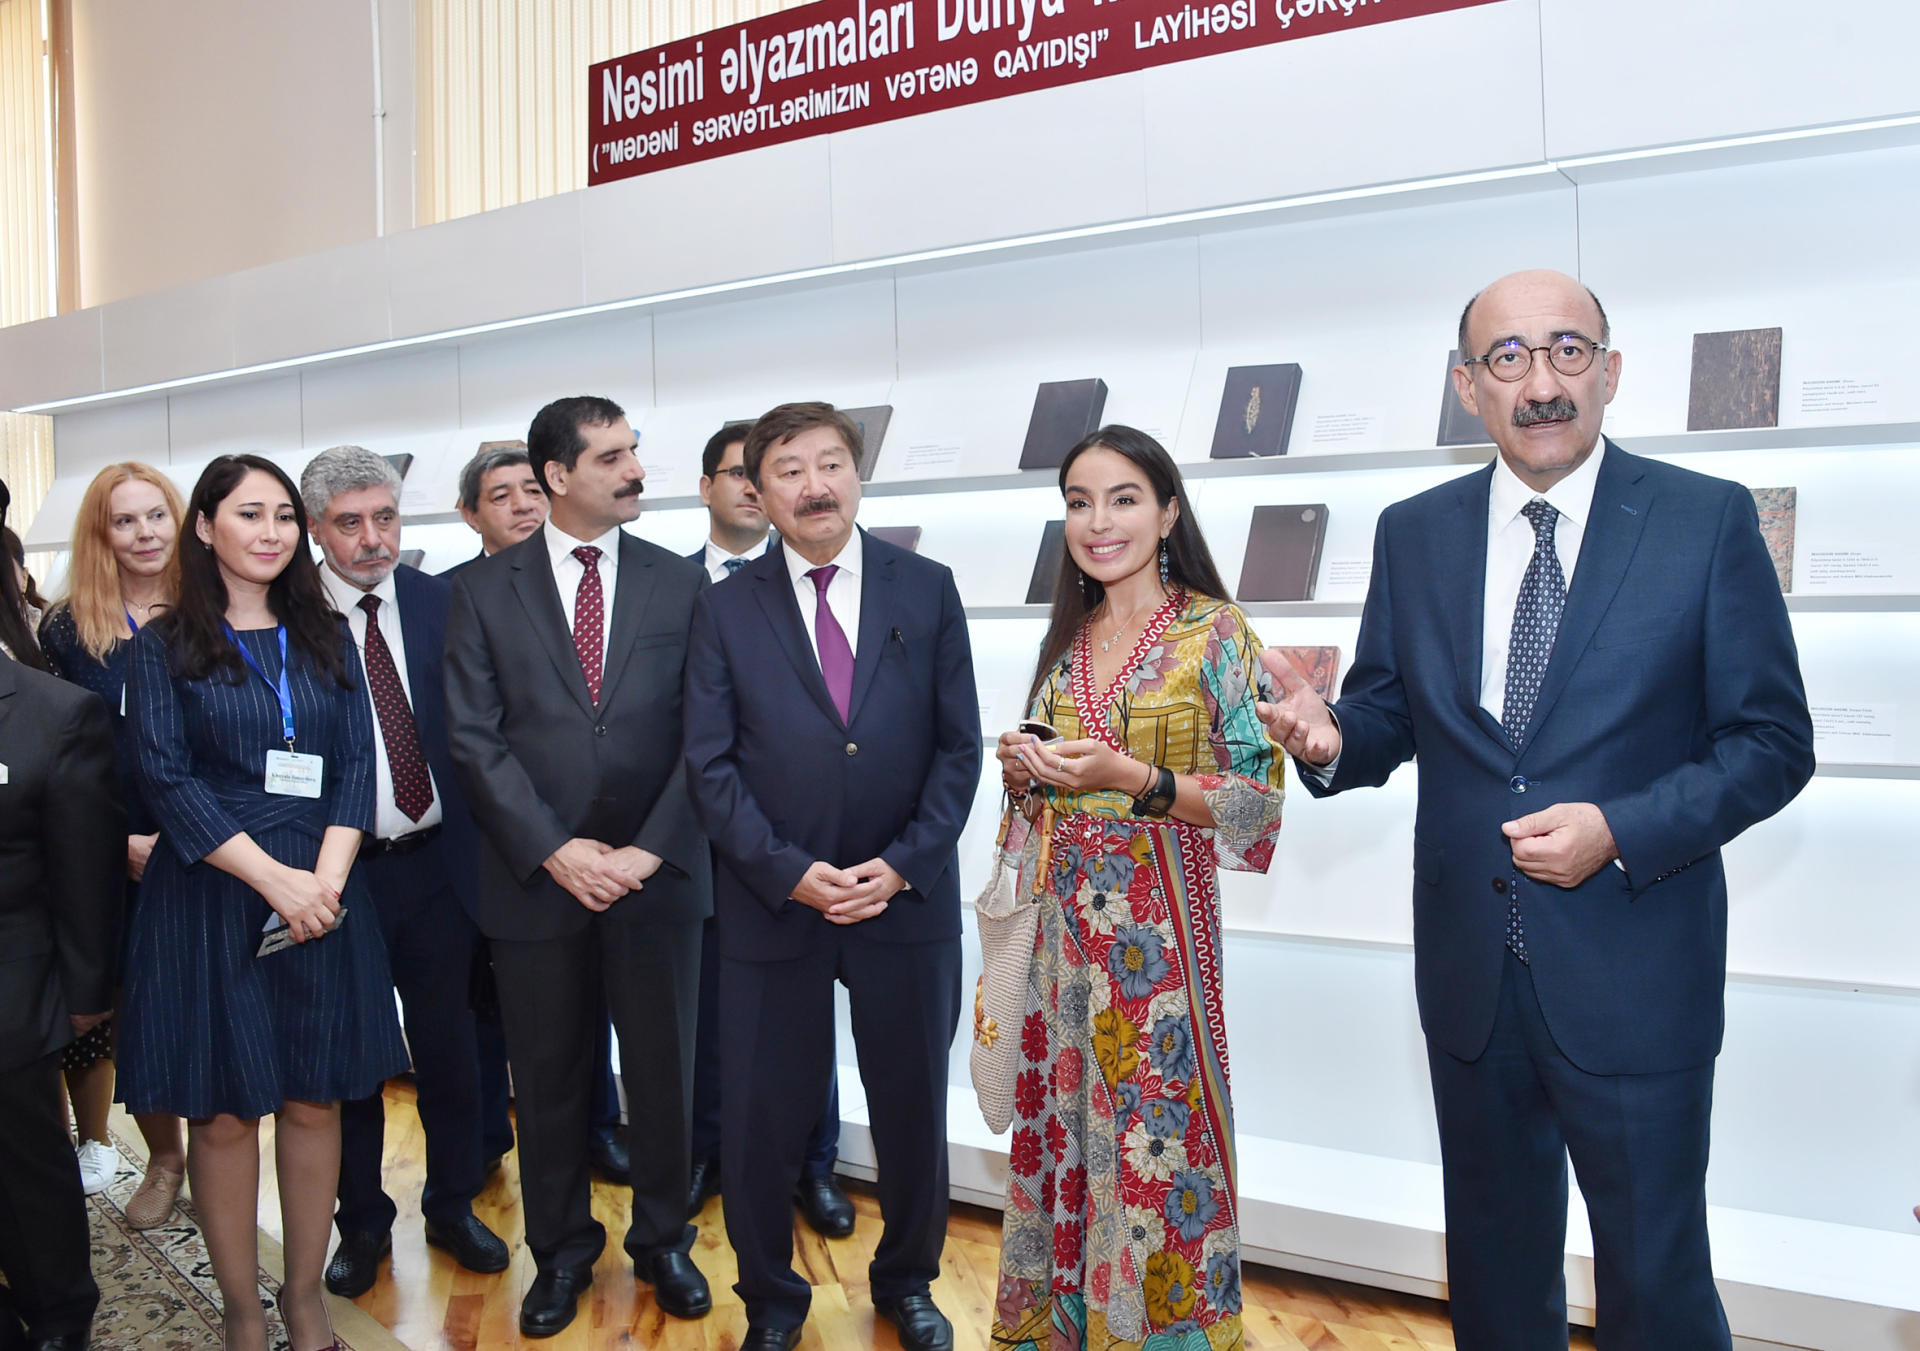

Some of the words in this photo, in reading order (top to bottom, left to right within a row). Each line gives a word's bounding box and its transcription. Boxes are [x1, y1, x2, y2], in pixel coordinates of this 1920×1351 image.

[603, 40, 704, 126] Nəsimi
[720, 0, 915, 105] əlyazmaları
[885, 58, 979, 102] VƏTƏNƏ
